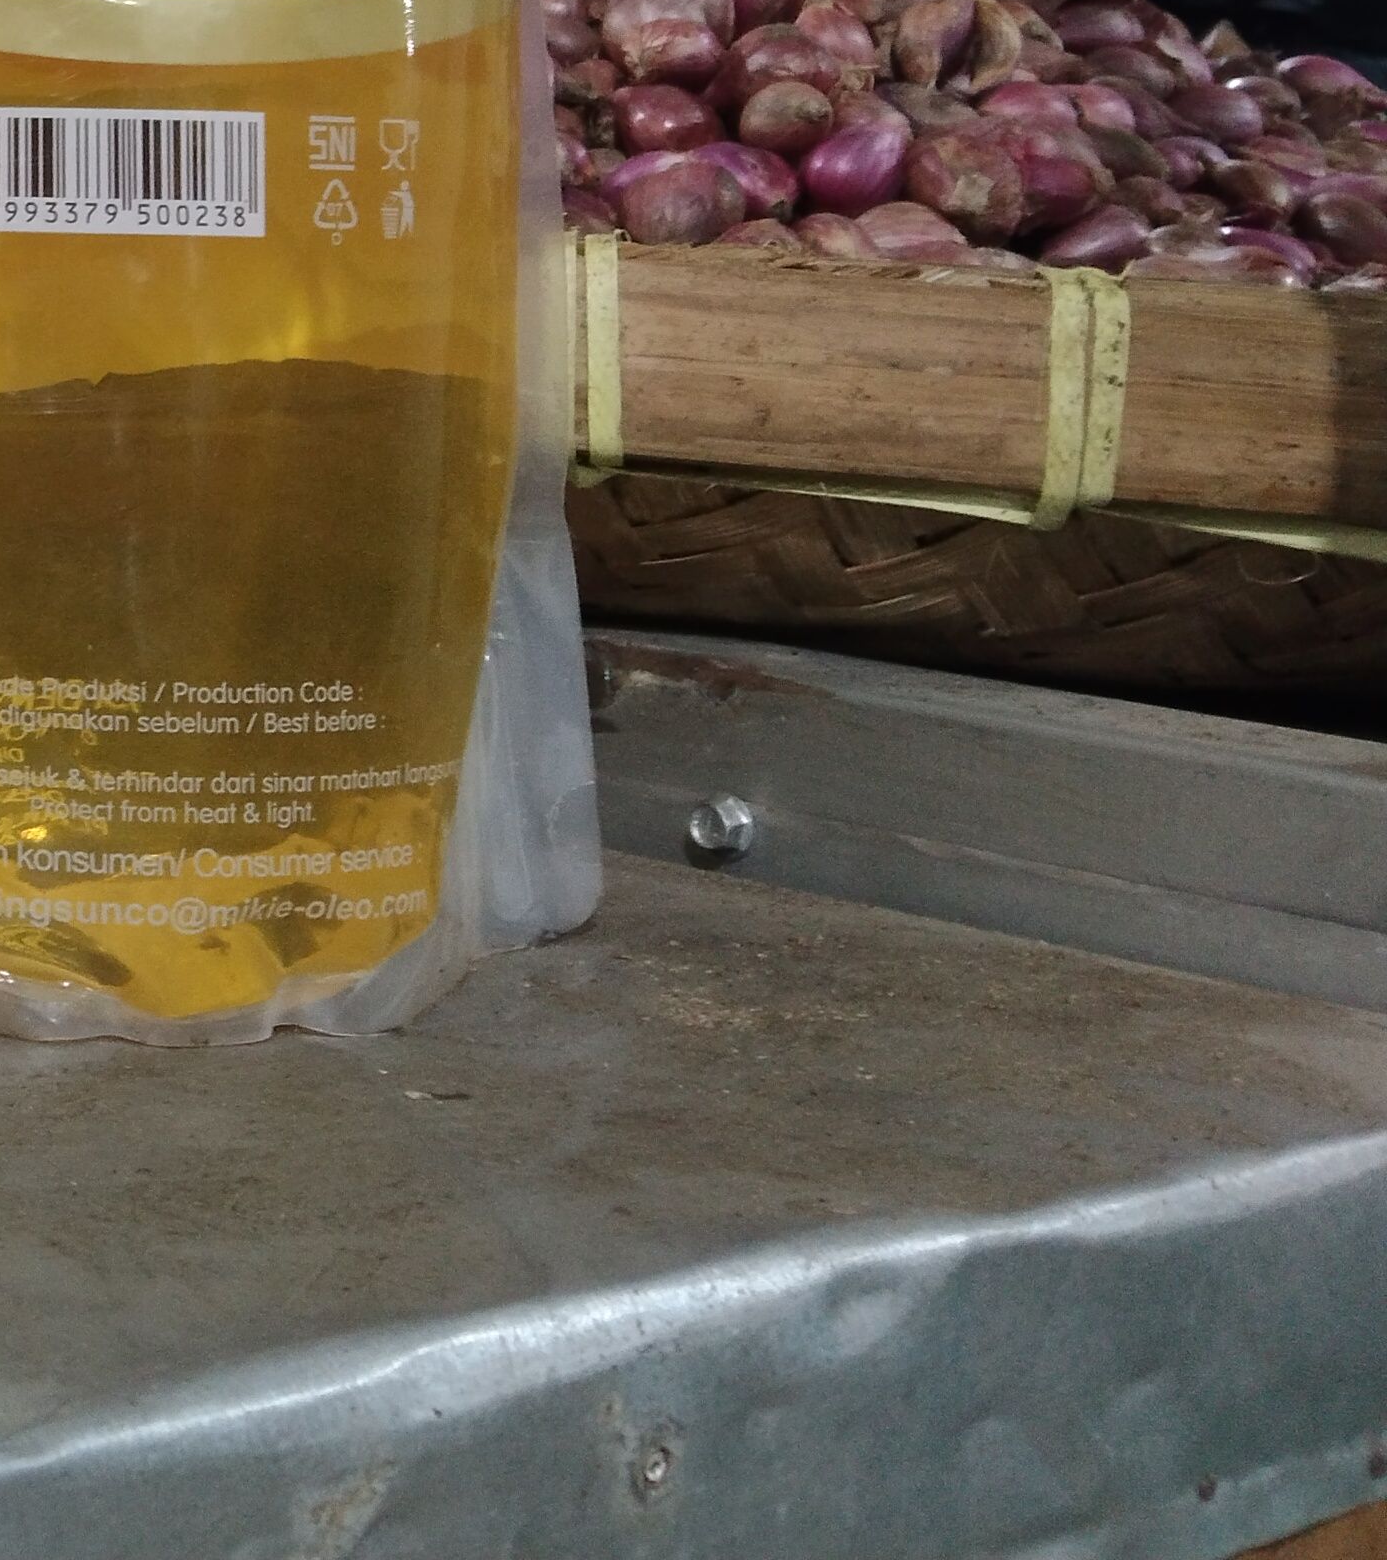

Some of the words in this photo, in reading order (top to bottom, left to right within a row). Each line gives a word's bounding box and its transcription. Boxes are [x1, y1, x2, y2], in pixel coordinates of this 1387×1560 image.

[309, 124, 356, 162] SNI
[3, 201, 120, 225] 993379
[136, 202, 247, 229] 500238
[41, 676, 147, 703] Produksi
[172, 680, 294, 704] Production
[0, 703, 130, 733] digunakan
[137, 711, 241, 735] sebelum
[263, 711, 311, 734] Best
[67, 768, 87, 790] &
[93, 769, 204, 795] terhindar
[210, 771, 256, 795] dari
[261, 772, 316, 794] sinar
[320, 764, 403, 792] matahari
[30, 794, 114, 822] Protect
[119, 800, 177, 824] from
[184, 801, 237, 825] heat
[243, 801, 260, 824] &
[267, 800, 317, 829] light.
[17, 840, 186, 878] konsumen/
[193, 847, 336, 879] Consumer
